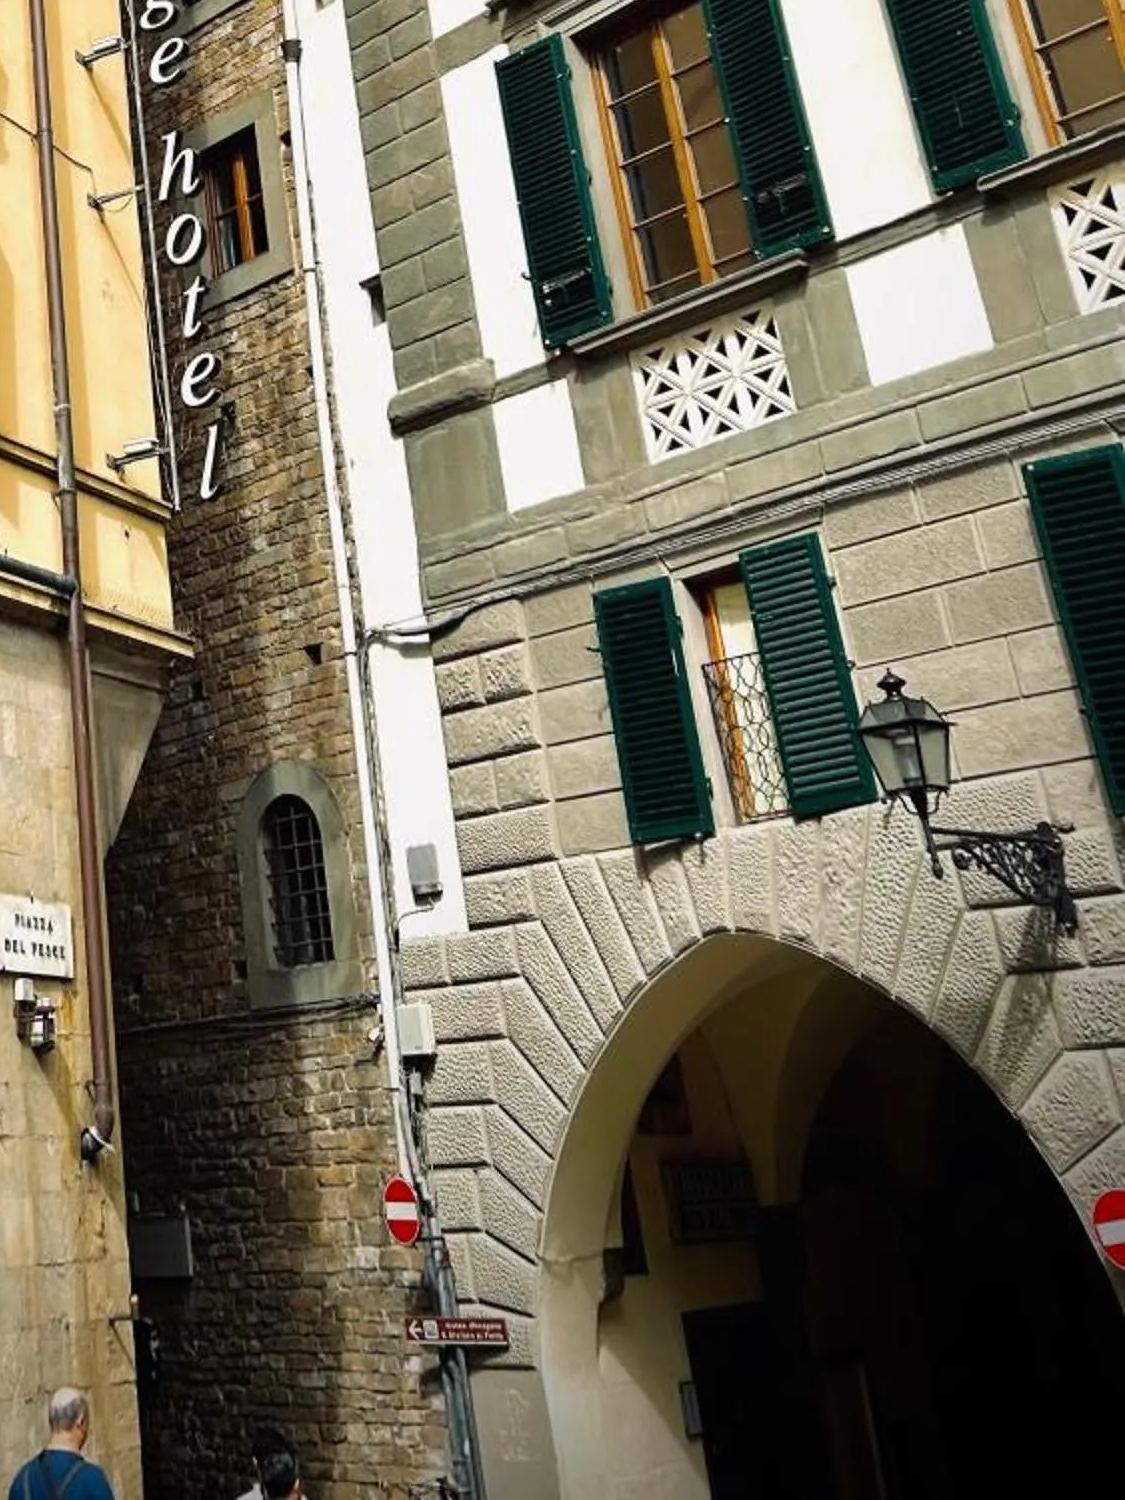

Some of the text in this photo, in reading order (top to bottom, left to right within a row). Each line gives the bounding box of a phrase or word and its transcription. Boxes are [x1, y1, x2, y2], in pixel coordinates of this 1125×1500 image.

[158, 131, 219, 501] hotel
[14, 913, 54, 934] PIAZZA
[4, 938, 66, 960] DEL PESCE
